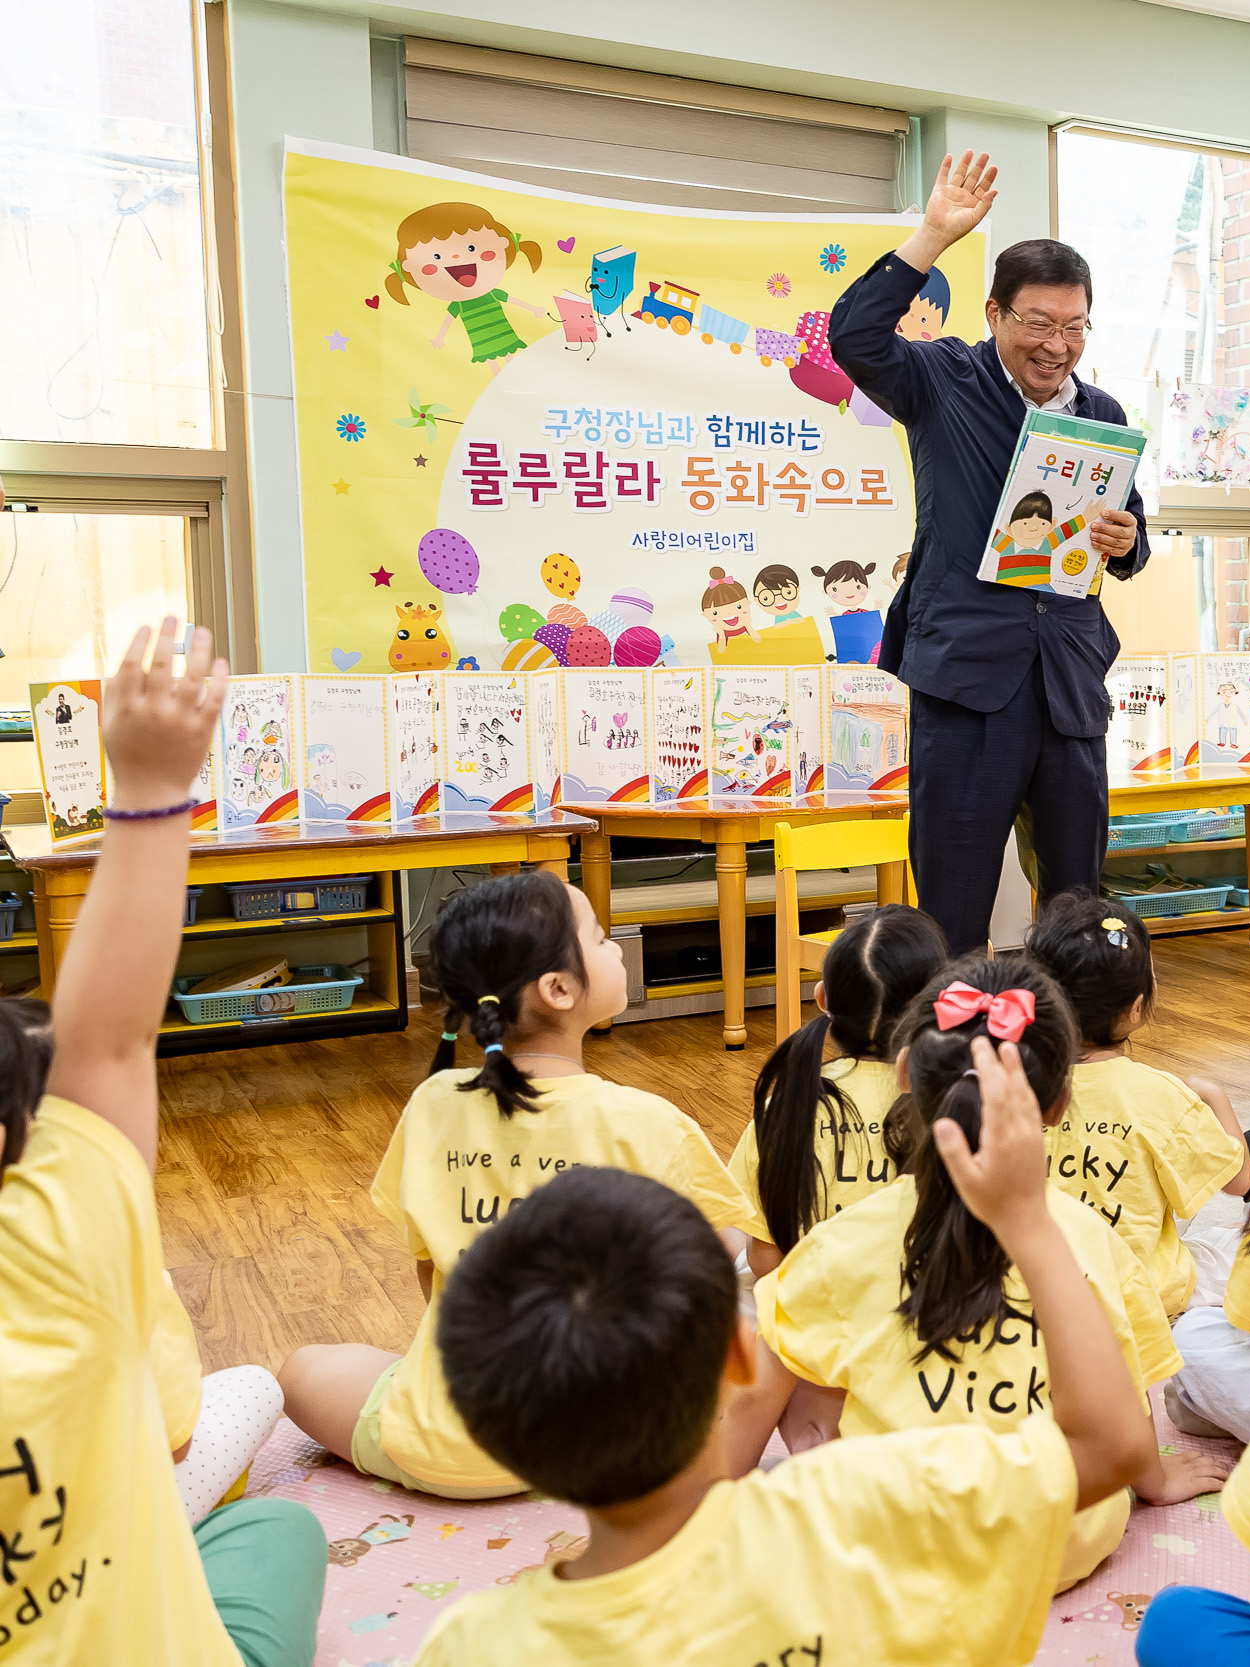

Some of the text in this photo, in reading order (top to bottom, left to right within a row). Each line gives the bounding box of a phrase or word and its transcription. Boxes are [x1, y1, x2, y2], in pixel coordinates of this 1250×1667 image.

[544, 407, 821, 450] 구청장님과 함께하는
[461, 442, 894, 513] 룰루랄라 동화속으로
[1037, 454, 1114, 495] 우리 형
[631, 530, 755, 551] 사랑의어린이집
[820, 1120, 881, 1139] Have
[1062, 1121, 1132, 1140] a very
[511, 1154, 521, 1167] a
[1046, 1145, 1129, 1192] cky
[918, 1366, 1046, 1415] Vick
